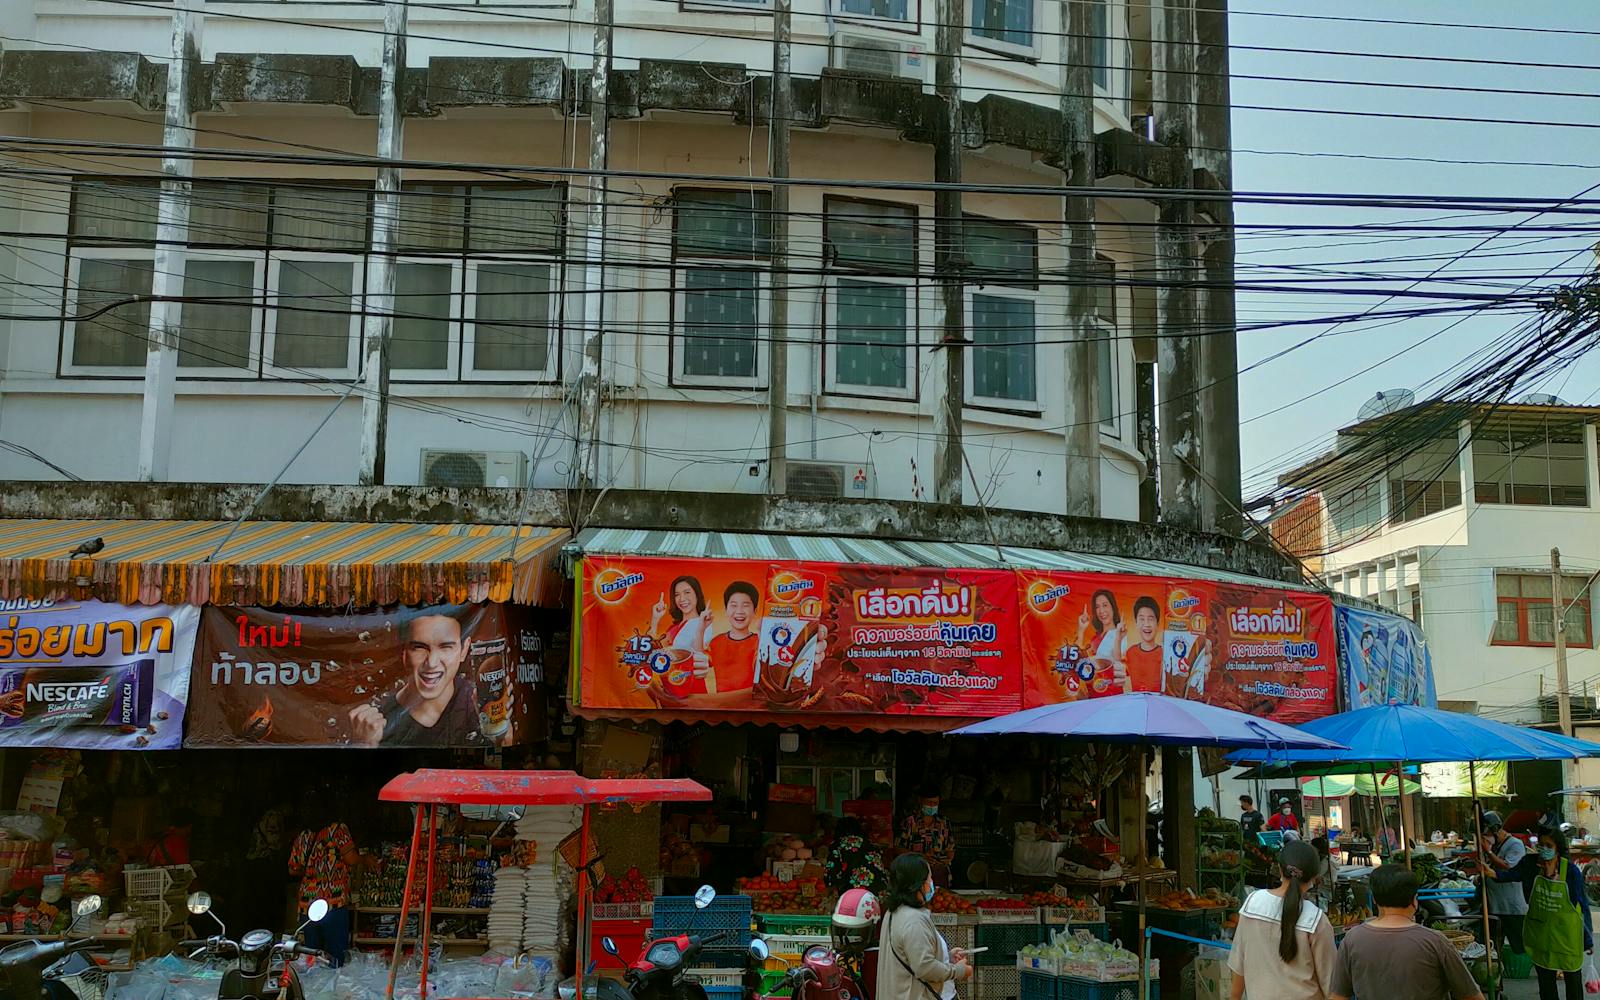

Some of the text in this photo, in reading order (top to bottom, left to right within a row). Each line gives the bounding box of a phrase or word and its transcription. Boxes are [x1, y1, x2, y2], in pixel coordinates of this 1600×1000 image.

[859, 579, 970, 616] เลือกดื่ม!
[236, 614, 302, 648] ใหม่!
[1231, 599, 1302, 633] เลือกดื่ม!
[630, 636, 652, 652] 15
[1061, 645, 1079, 661] 15
[210, 652, 321, 685] ท้าลอง
